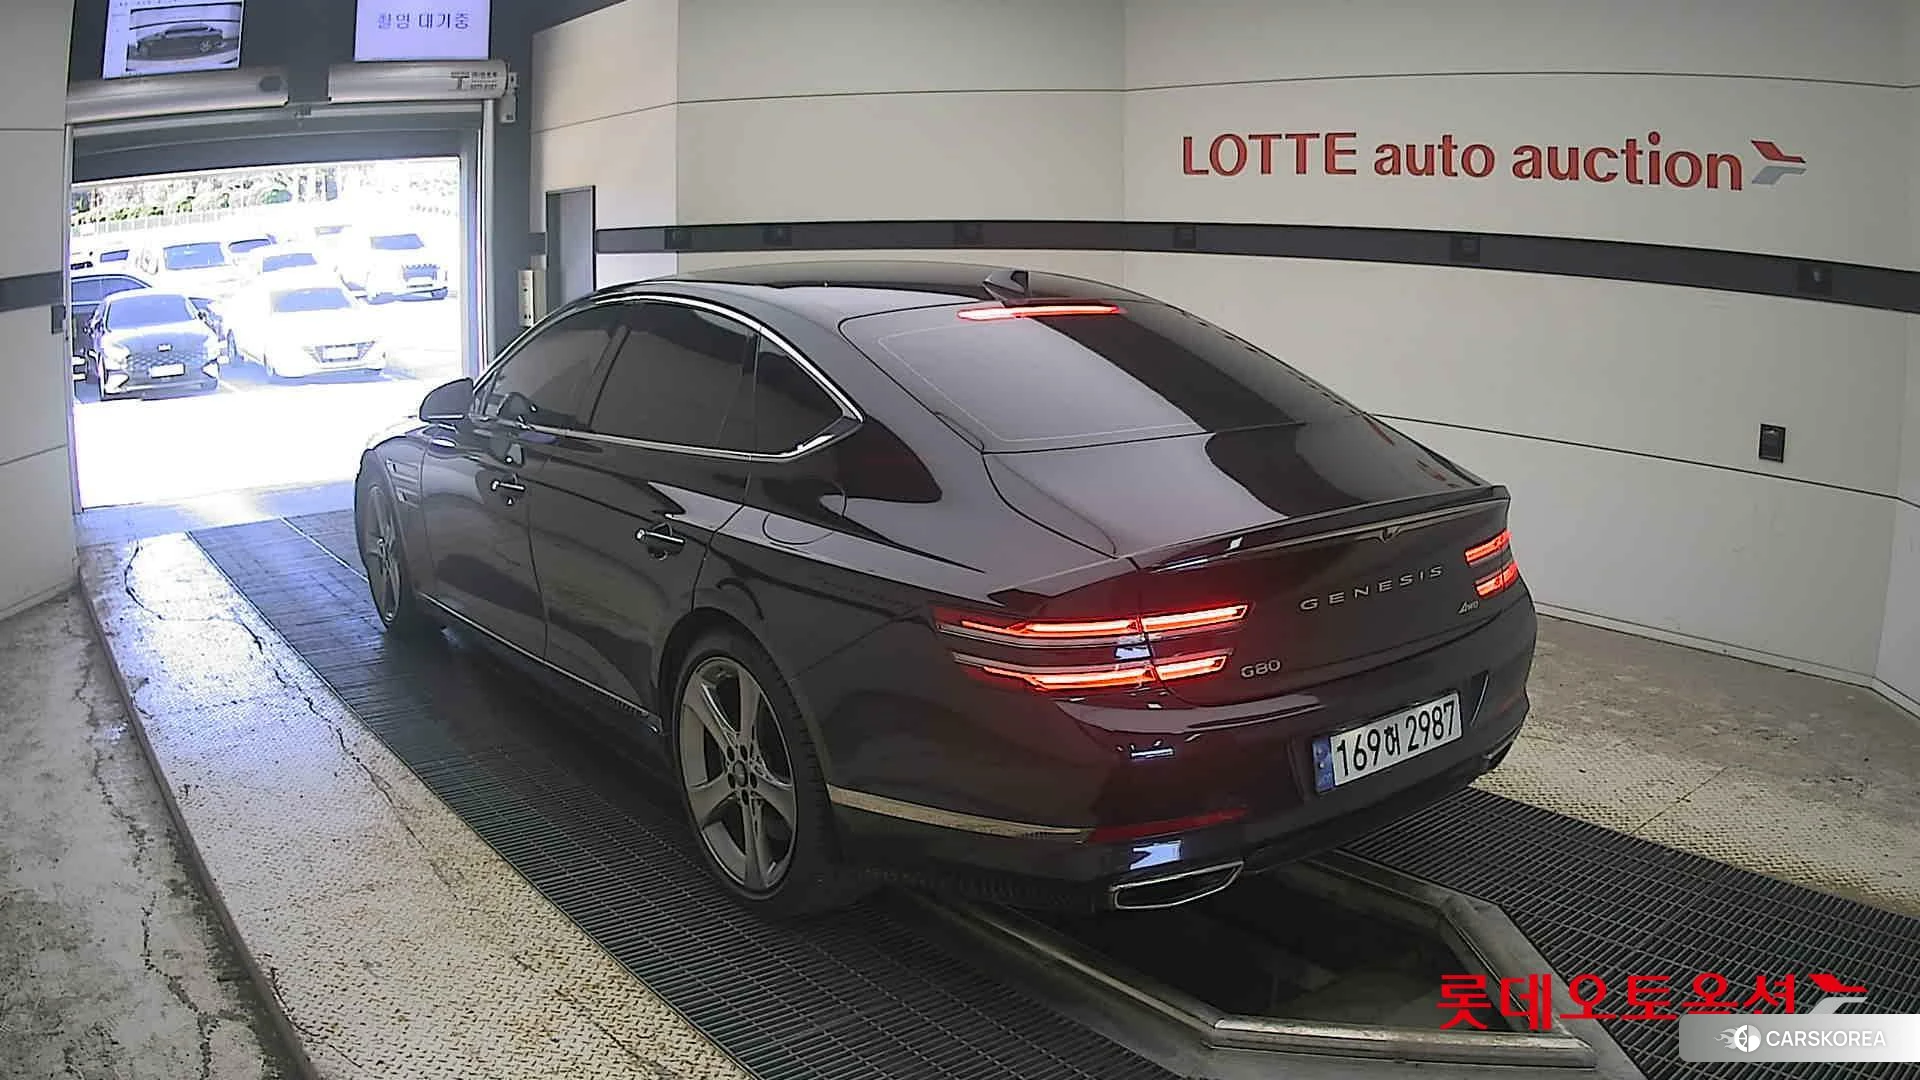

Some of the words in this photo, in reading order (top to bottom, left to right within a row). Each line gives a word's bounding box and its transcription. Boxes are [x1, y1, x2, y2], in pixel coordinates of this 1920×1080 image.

[418, 13, 468, 29] 대기중
[1183, 132, 1357, 176] LOTTE
[1374, 135, 1495, 178] auto
[1512, 131, 1743, 191] auction
[1300, 566, 1443, 610] GENESIS
[1240, 660, 1281, 678] G80
[1336, 723, 1401, 776] 169허
[1405, 701, 1455, 752] 2987
